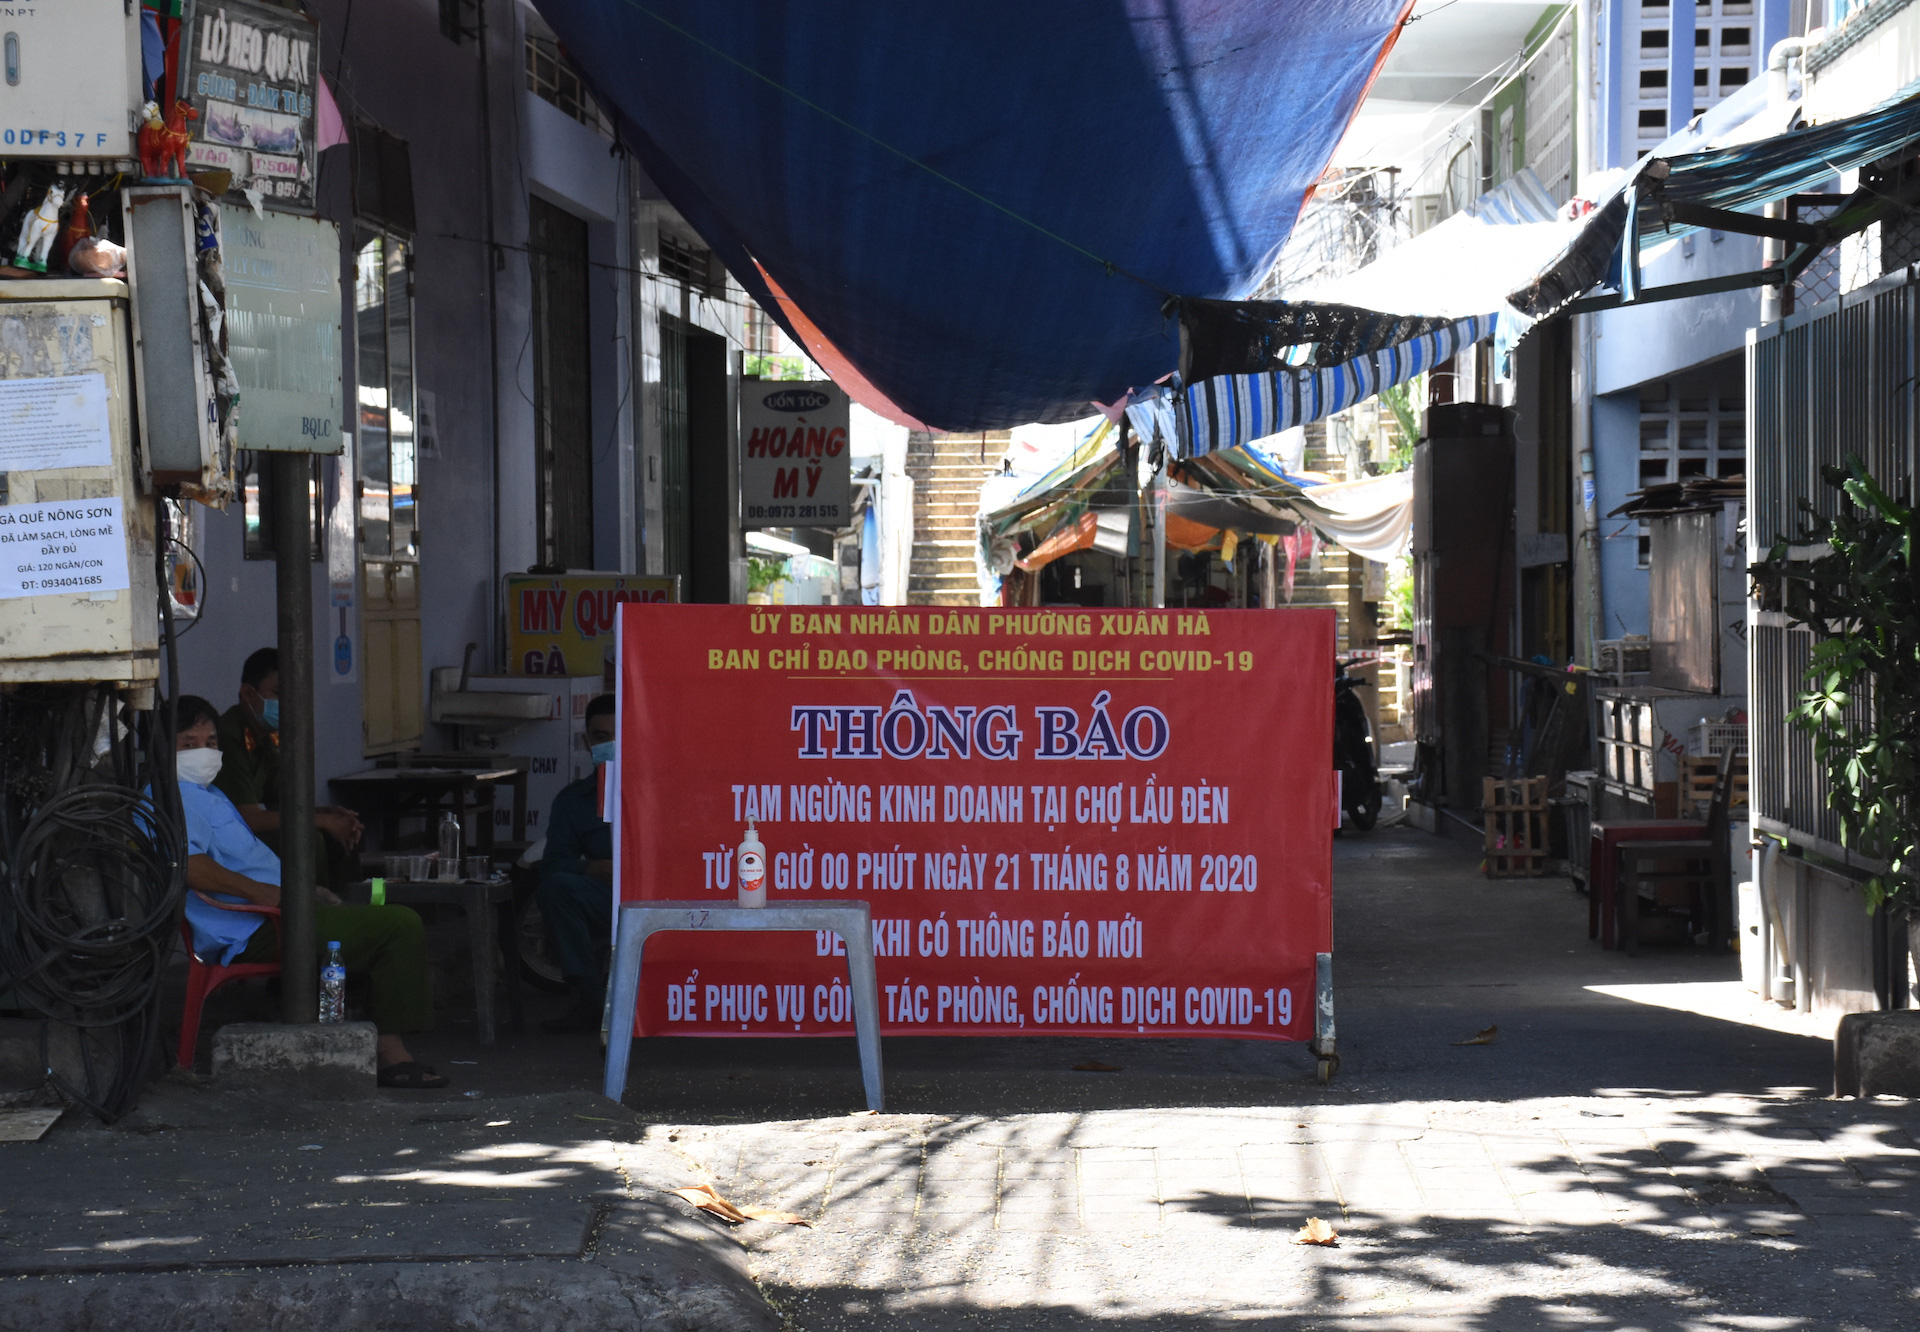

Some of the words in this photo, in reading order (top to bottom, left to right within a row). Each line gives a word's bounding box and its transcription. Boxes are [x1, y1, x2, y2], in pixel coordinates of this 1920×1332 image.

[199, 8, 228, 64] LÒ
[227, 21, 264, 74] HEO
[265, 31, 310, 85] QUAY
[197, 70, 237, 101] CÚNG
[248, 81, 280, 110] ĐÁM
[768, 392, 795, 408] UỐN
[799, 392, 826, 408] TÓC
[302, 417, 331, 440] BQLC
[748, 416, 847, 458] HOÀNG
[773, 458, 822, 499] MỸ
[19, 510, 44, 524] QUÊ
[48, 508, 84, 522] NÔNG
[87, 506, 113, 519] SƠN
[799, 505, 817, 518] 281
[822, 504, 839, 517] 515
[1, 530, 15, 543] ĐÃ
[17, 529, 39, 541] LÀM
[40, 530, 68, 541] SẠCH,
[71, 527, 96, 539] LÒNG
[63, 542, 77, 554] ĐỦ
[17, 562, 37, 573] GIÁ:
[38, 563, 53, 572] 120
[55, 558, 103, 571] NGÀN/CON
[21, 579, 39, 590] ĐT:
[41, 575, 103, 588] 0934041685
[521, 580, 567, 633] MỲ
[751, 607, 781, 634] ỦY
[790, 613, 841, 635] BAN
[851, 610, 920, 635] NHÂN
[929, 610, 980, 635] DÂN
[989, 610, 1091, 635] PHƯỜNG
[1100, 610, 1169, 635] XUÂN
[1177, 609, 1211, 635] HÀ
[523, 644, 568, 675] GÀ
[708, 649, 760, 670] BAN
[768, 643, 810, 670] CHỈ
[817, 649, 868, 675] ĐẠO
[877, 645, 969, 673] PHÒNG,
[978, 643, 1064, 671] CHỐNG
[1072, 650, 1131, 676] DỊCH
[1139, 650, 1253, 671] COVID-19
[790, 689, 1023, 761] THÔNG
[1035, 690, 1170, 761] BÁO
[790, 776, 871, 822] NGỪNG
[880, 784, 936, 822] KINH
[944, 785, 1023, 823] DOANH
[1031, 785, 1067, 832] TẠI
[1075, 781, 1124, 832] CHỢ
[1130, 773, 1174, 824] LẦU
[1181, 778, 1229, 824] ĐÈN
[702, 843, 734, 890] TỪ
[774, 843, 815, 890] GIỜ
[857, 844, 917, 890] PHÚT
[925, 844, 987, 890] NGÀY
[994, 853, 1020, 891] 21
[1030, 846, 1107, 891] THÁNG
[1115, 853, 1130, 891] 8
[1137, 845, 1192, 891] NĂM
[1200, 854, 1258, 892] 2020
[872, 919, 910, 957] KHI
[918, 911, 949, 957] CÓ
[957, 911, 1034, 958] THÔNG
[1043, 911, 1089, 958] BÁO
[1098, 912, 1143, 958] MỚI
[667, 969, 699, 1022] ĐỂ
[705, 984, 768, 1031] PHỤC
[775, 984, 805, 1031] VỤ
[885, 977, 929, 1023] TÁC
[937, 976, 1025, 1028] PHÒNG,
[1033, 972, 1113, 1024] CHỐNG
[1121, 986, 1177, 1033] DỊCH
[1184, 987, 1292, 1026] COVID-19
